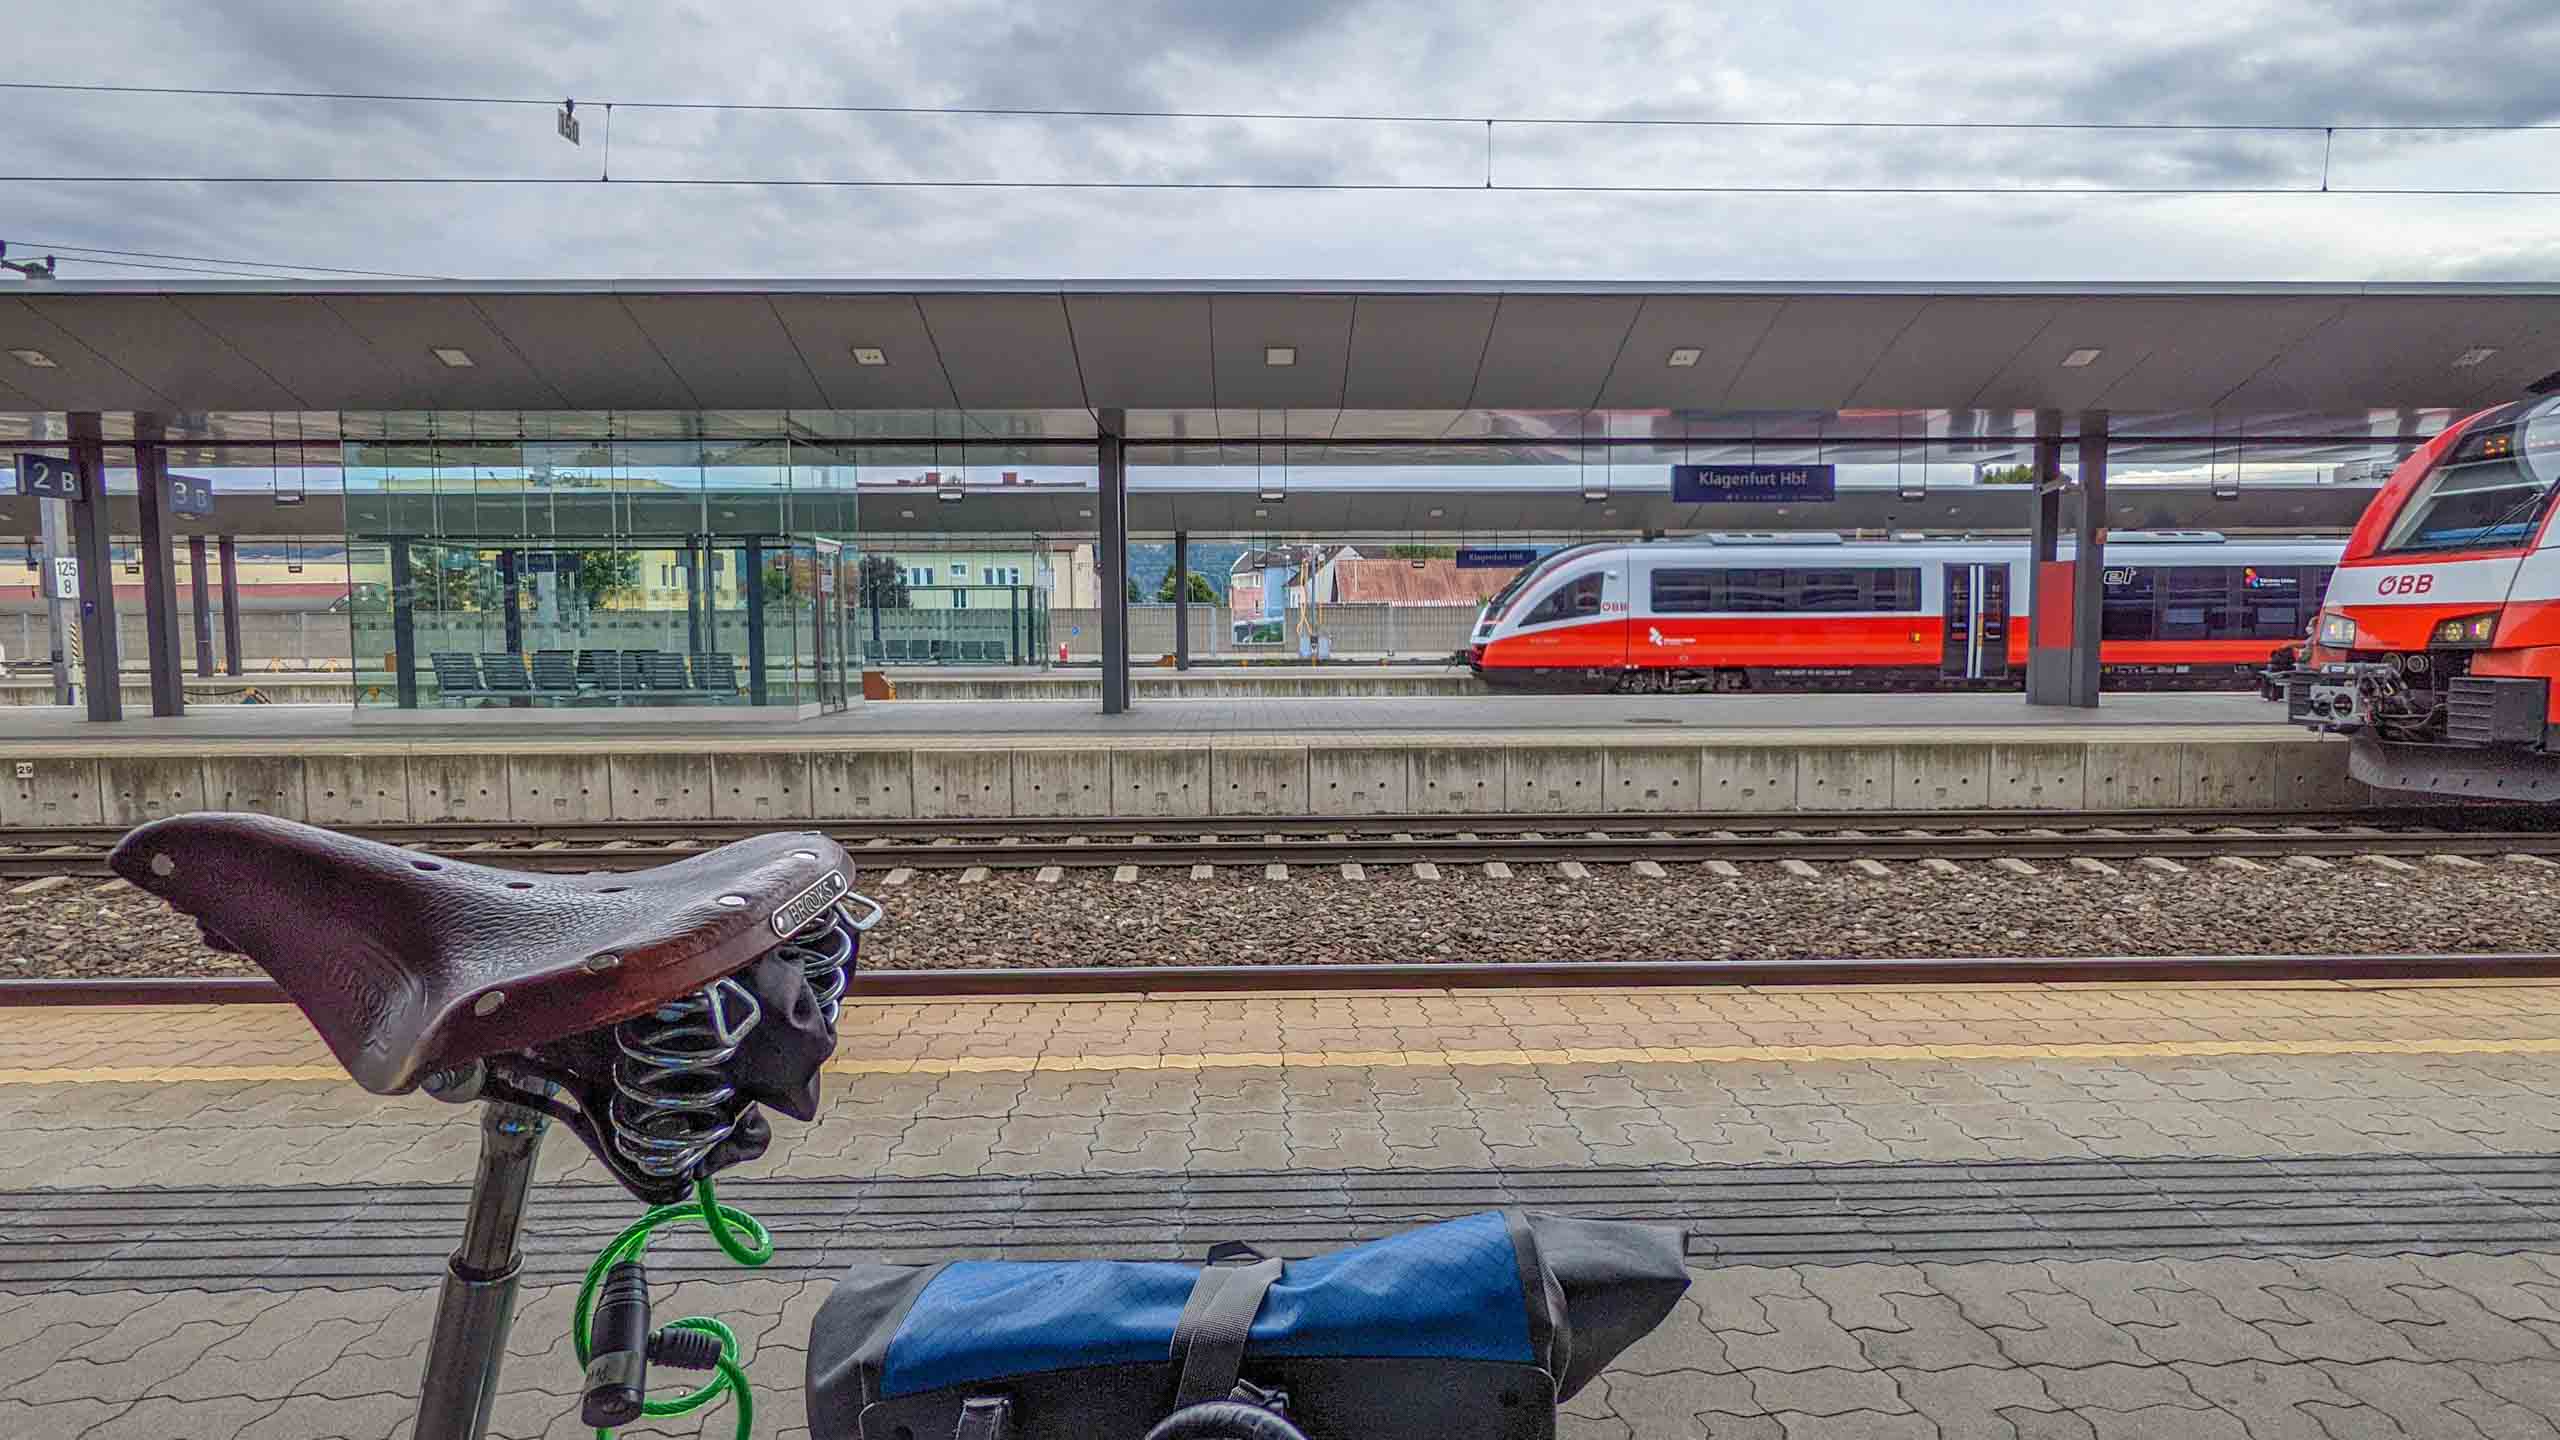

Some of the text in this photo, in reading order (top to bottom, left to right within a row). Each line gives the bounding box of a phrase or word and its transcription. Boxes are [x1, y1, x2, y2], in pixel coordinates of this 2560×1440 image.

[33, 463, 75, 492] 2 B
[1699, 472, 1808, 488] Klagenfurt Hbf
[174, 482, 187, 505] 3
[57, 561, 76, 577] 125
[63, 579, 71, 593] 8
[2378, 574, 2434, 596] ÖBB
[788, 880, 835, 925] BROOKS
